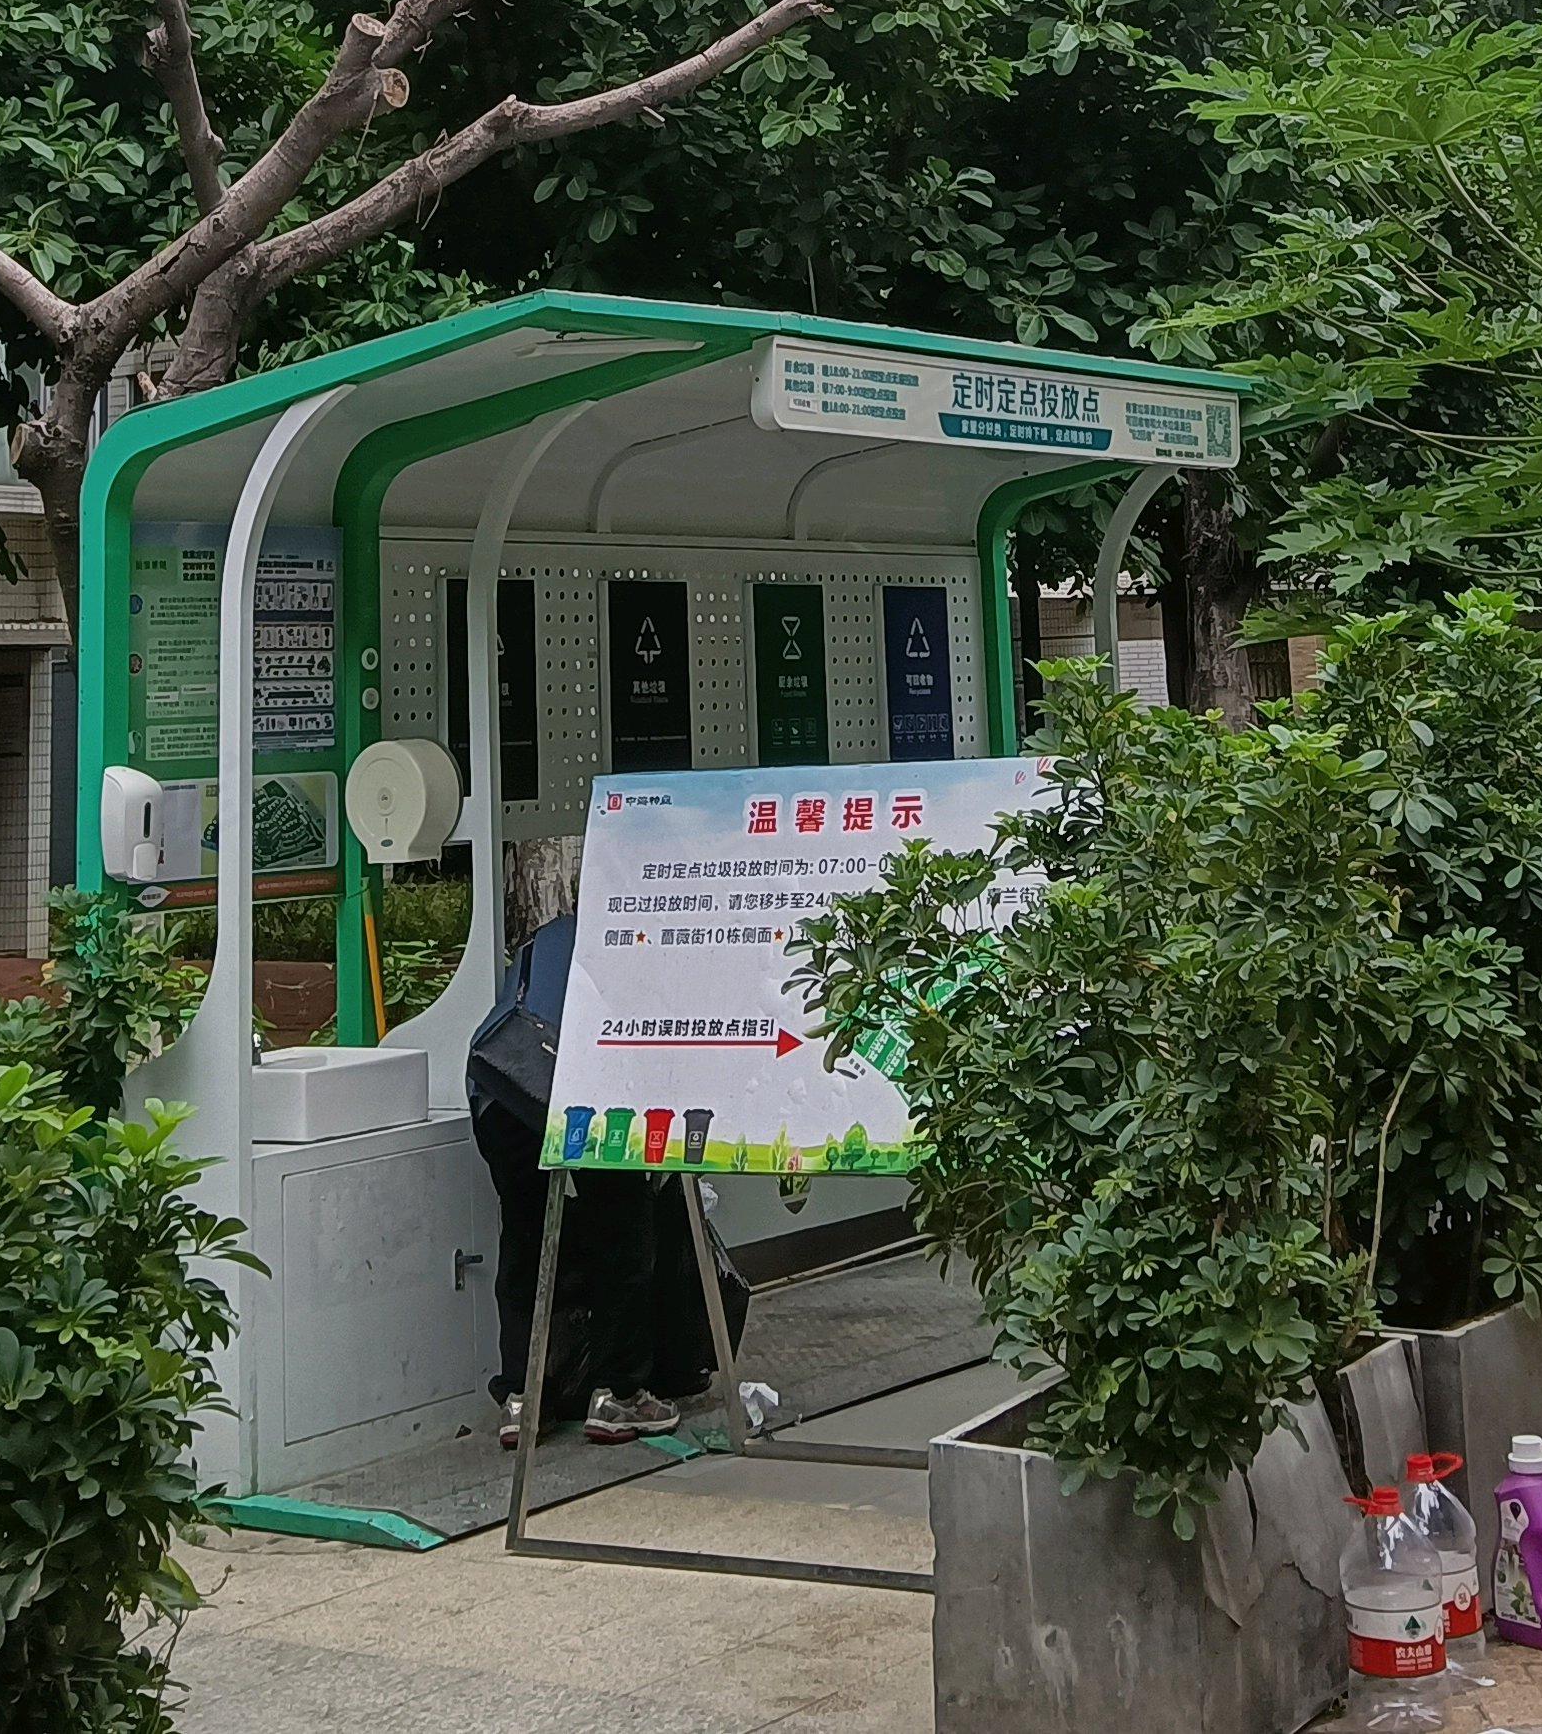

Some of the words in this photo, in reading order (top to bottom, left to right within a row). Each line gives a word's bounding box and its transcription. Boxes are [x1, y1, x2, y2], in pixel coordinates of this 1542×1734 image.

[952, 371, 1101, 424] 定时定点投放点
[748, 794, 924, 834] 温馨提示
[642, 857, 891, 881] 定时定点垃圾投放时间为:07:00-0
[601, 1018, 775, 1037] 24小时误时投放点指引
